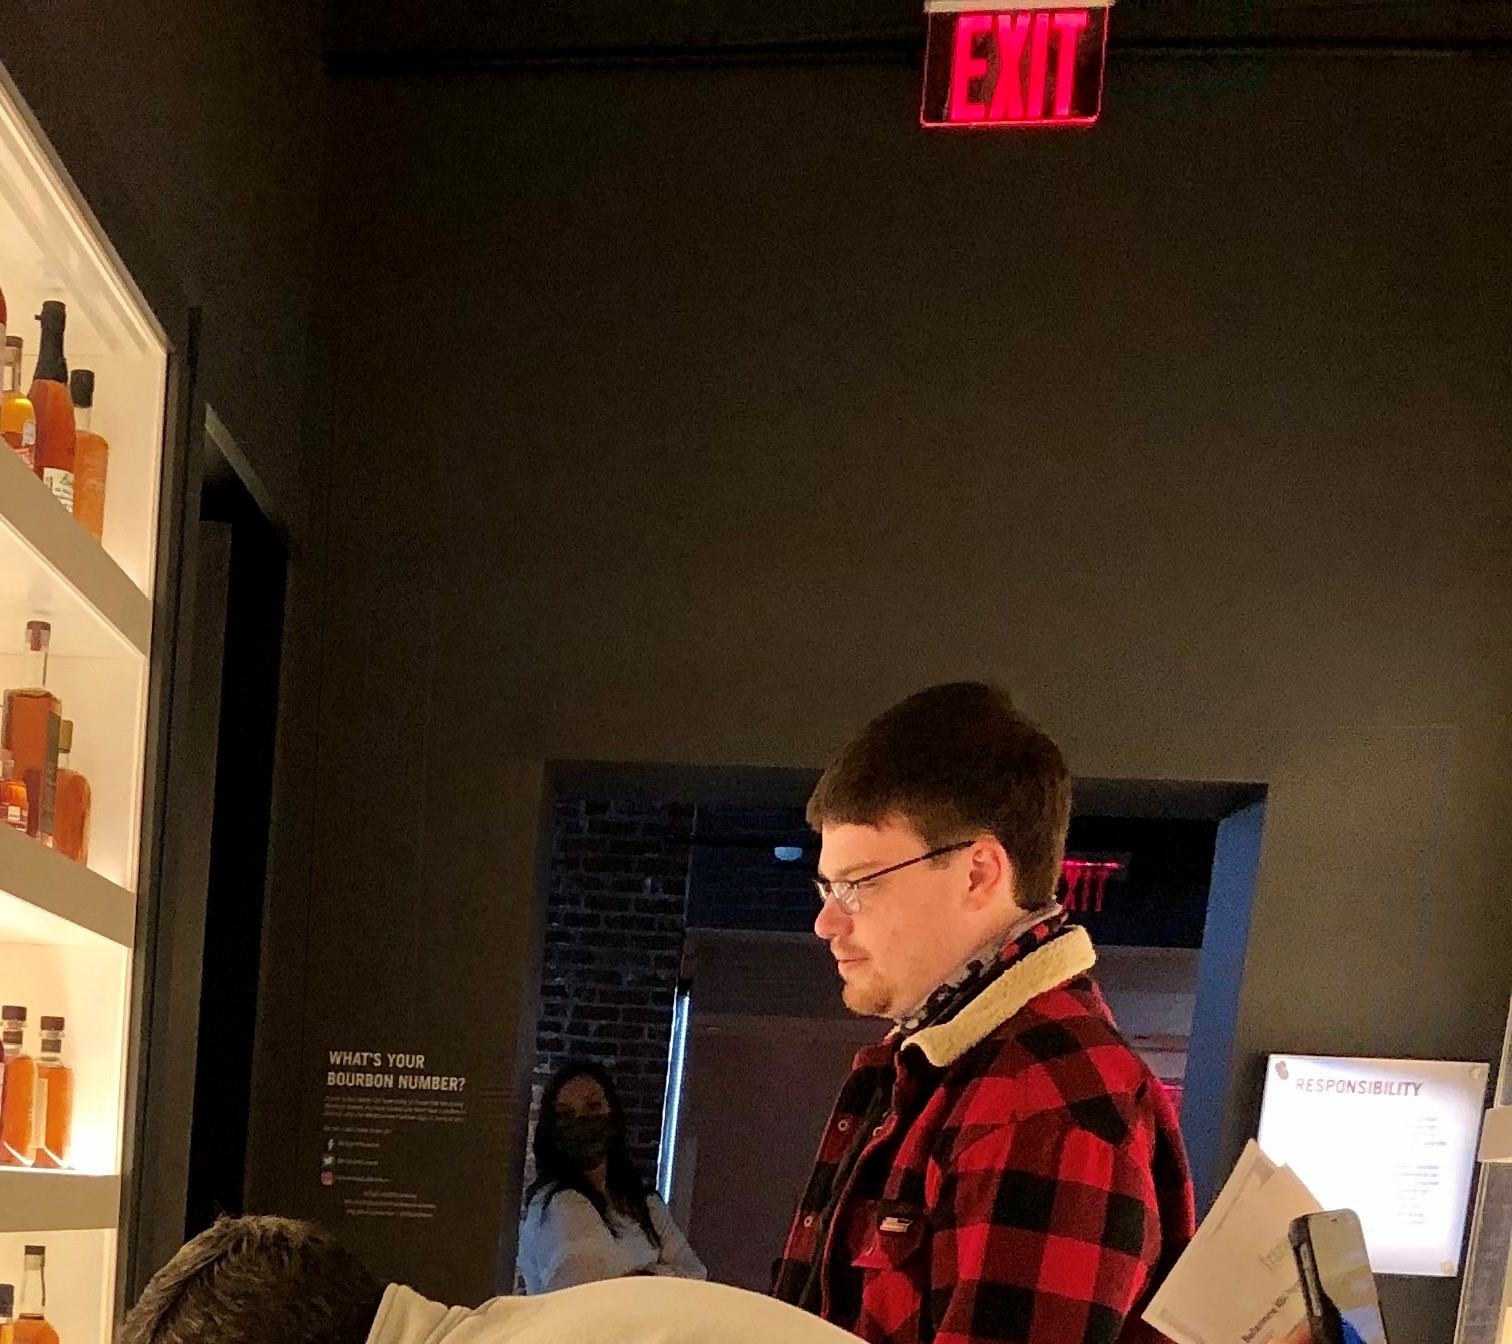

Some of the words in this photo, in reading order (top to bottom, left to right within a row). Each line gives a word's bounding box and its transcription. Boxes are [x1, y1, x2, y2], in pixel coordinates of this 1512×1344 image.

[950, 11, 1089, 120] EXIT
[1061, 866, 1110, 913] XIT
[328, 1050, 382, 1068] WHAT'S
[387, 1052, 426, 1070] YOUR
[326, 1071, 394, 1089] BOURBON
[397, 1075, 467, 1093] NUMBER?
[1294, 1077, 1426, 1098] RESPONSIBILITY
